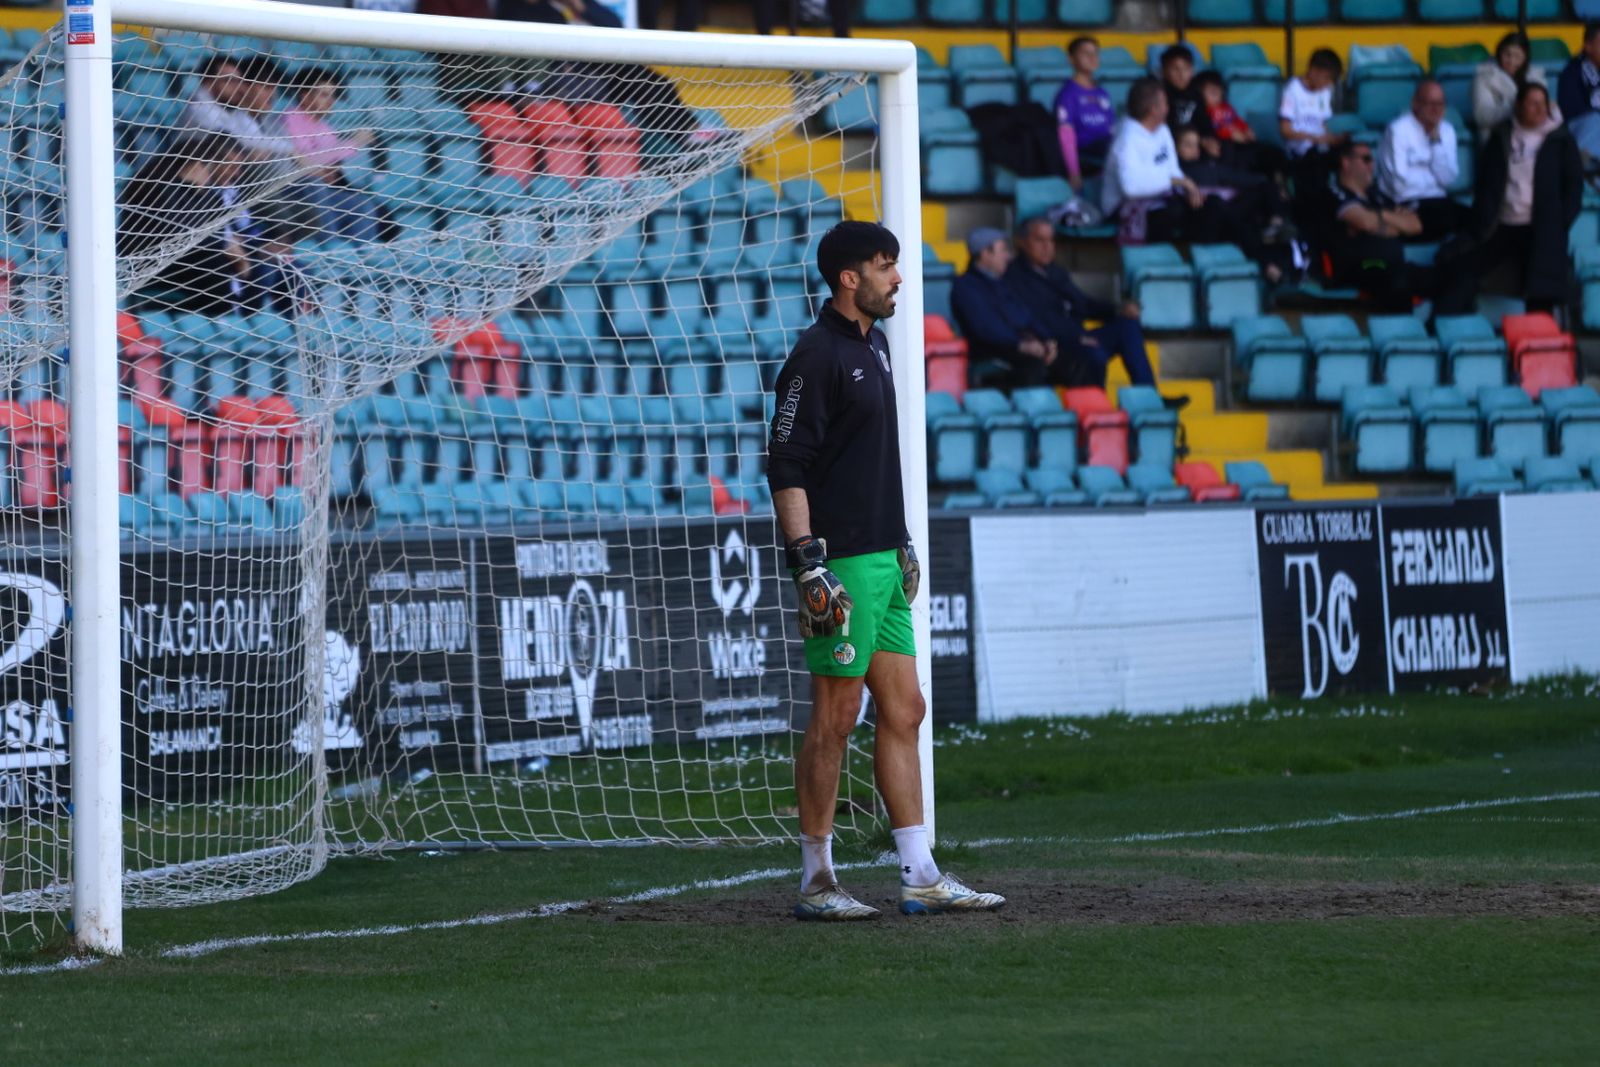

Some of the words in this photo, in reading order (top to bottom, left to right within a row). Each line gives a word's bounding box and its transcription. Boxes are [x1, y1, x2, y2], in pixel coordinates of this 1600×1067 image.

[776, 375, 804, 443] umbro
[1262, 512, 1315, 545] CUADRA
[122, 598, 274, 660] NTAGLORIA
[1392, 614, 1482, 673] CHARRAS
[0, 699, 65, 749] SA
